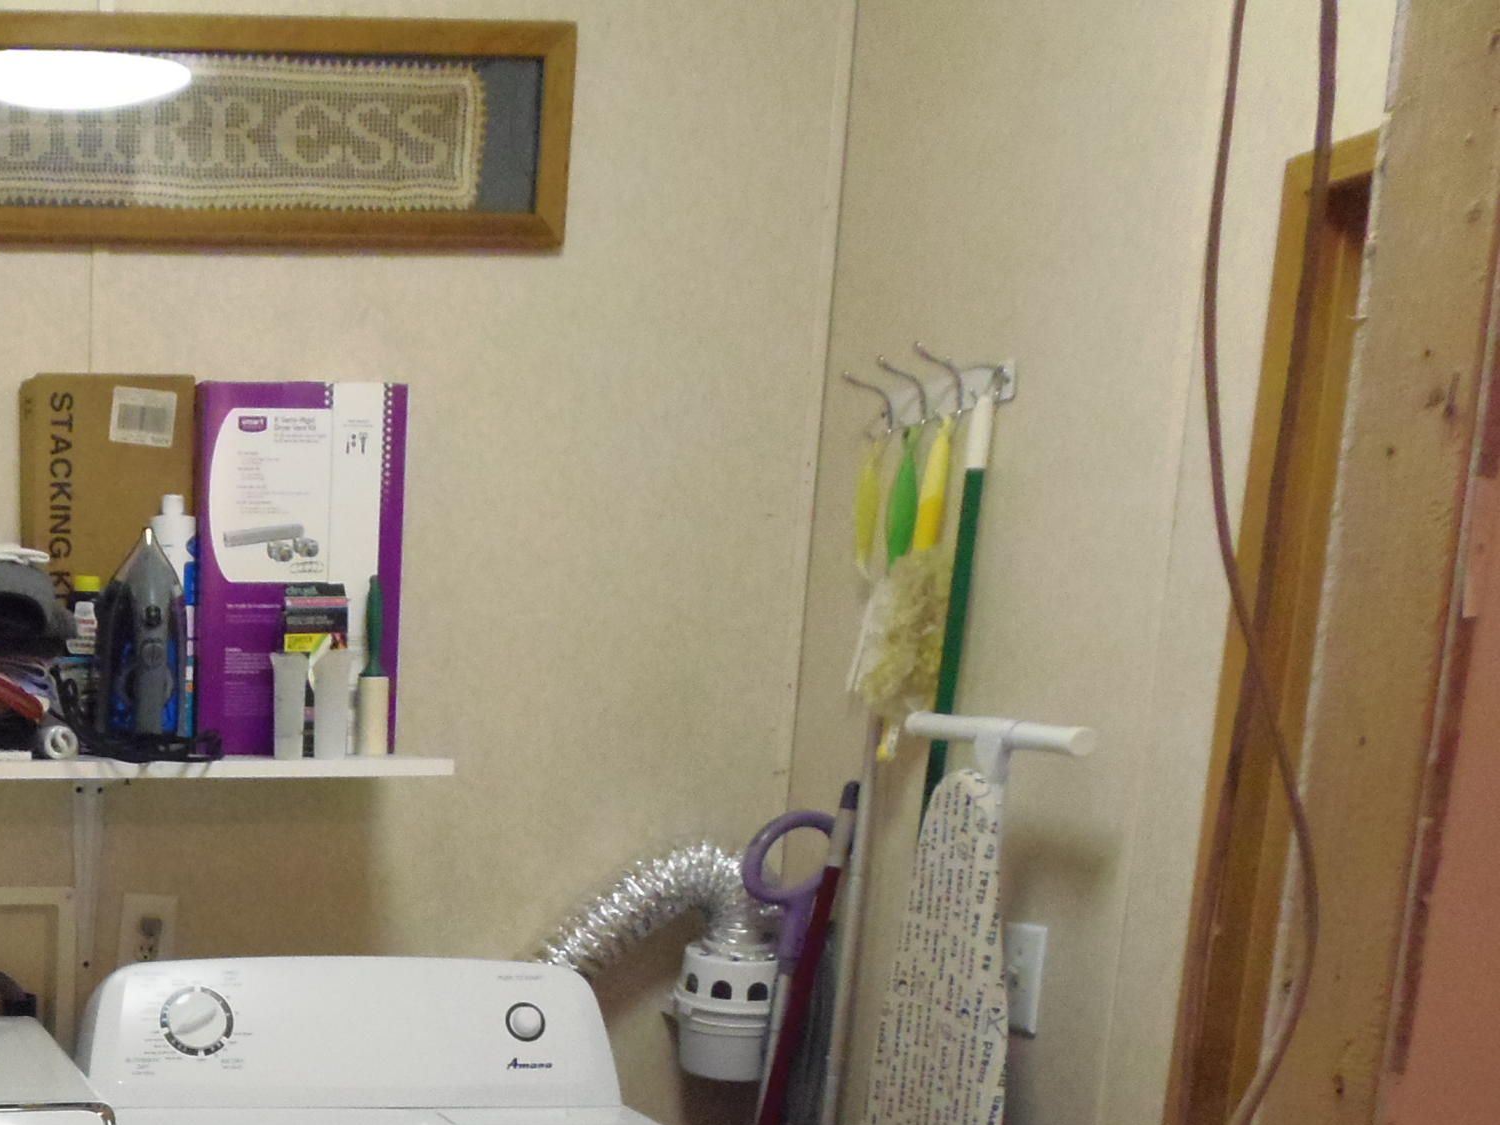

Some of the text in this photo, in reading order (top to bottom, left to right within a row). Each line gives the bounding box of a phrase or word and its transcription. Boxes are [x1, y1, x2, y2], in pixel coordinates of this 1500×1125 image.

[48, 391, 74, 559] STACKING
[974, 869, 990, 904] dial
[506, 1056, 553, 1070] Amana
